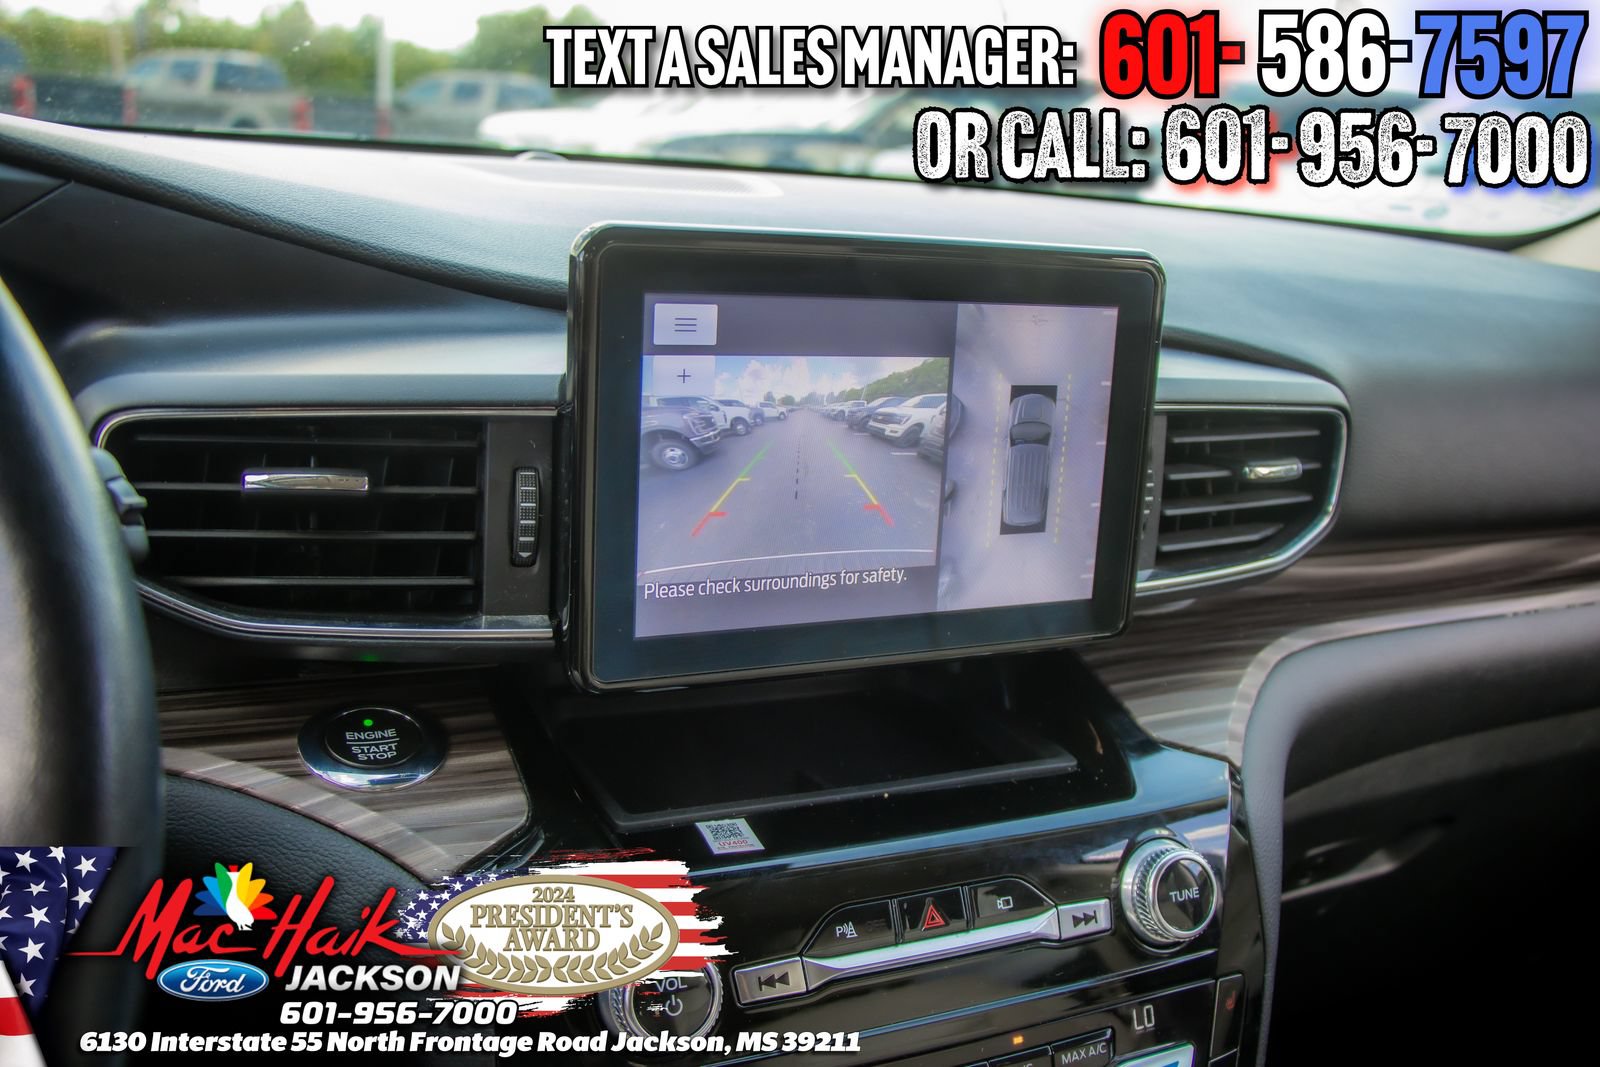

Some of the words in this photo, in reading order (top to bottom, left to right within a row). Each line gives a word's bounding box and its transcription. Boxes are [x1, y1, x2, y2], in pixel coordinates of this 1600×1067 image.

[644, 582, 695, 599] Please
[698, 577, 741, 596] check
[744, 572, 837, 592] surroundings
[840, 569, 860, 585] for
[862, 567, 907, 584] safety.
[345, 728, 397, 740] ENGINE
[351, 742, 398, 754] START
[357, 751, 397, 761] STOP
[1169, 886, 1200, 903] TUNE
[655, 976, 687, 993] VOL
[1133, 1004, 1156, 1031] LO
[1061, 1048, 1087, 1065] MAX
[1088, 1042, 1107, 1057] A/C
